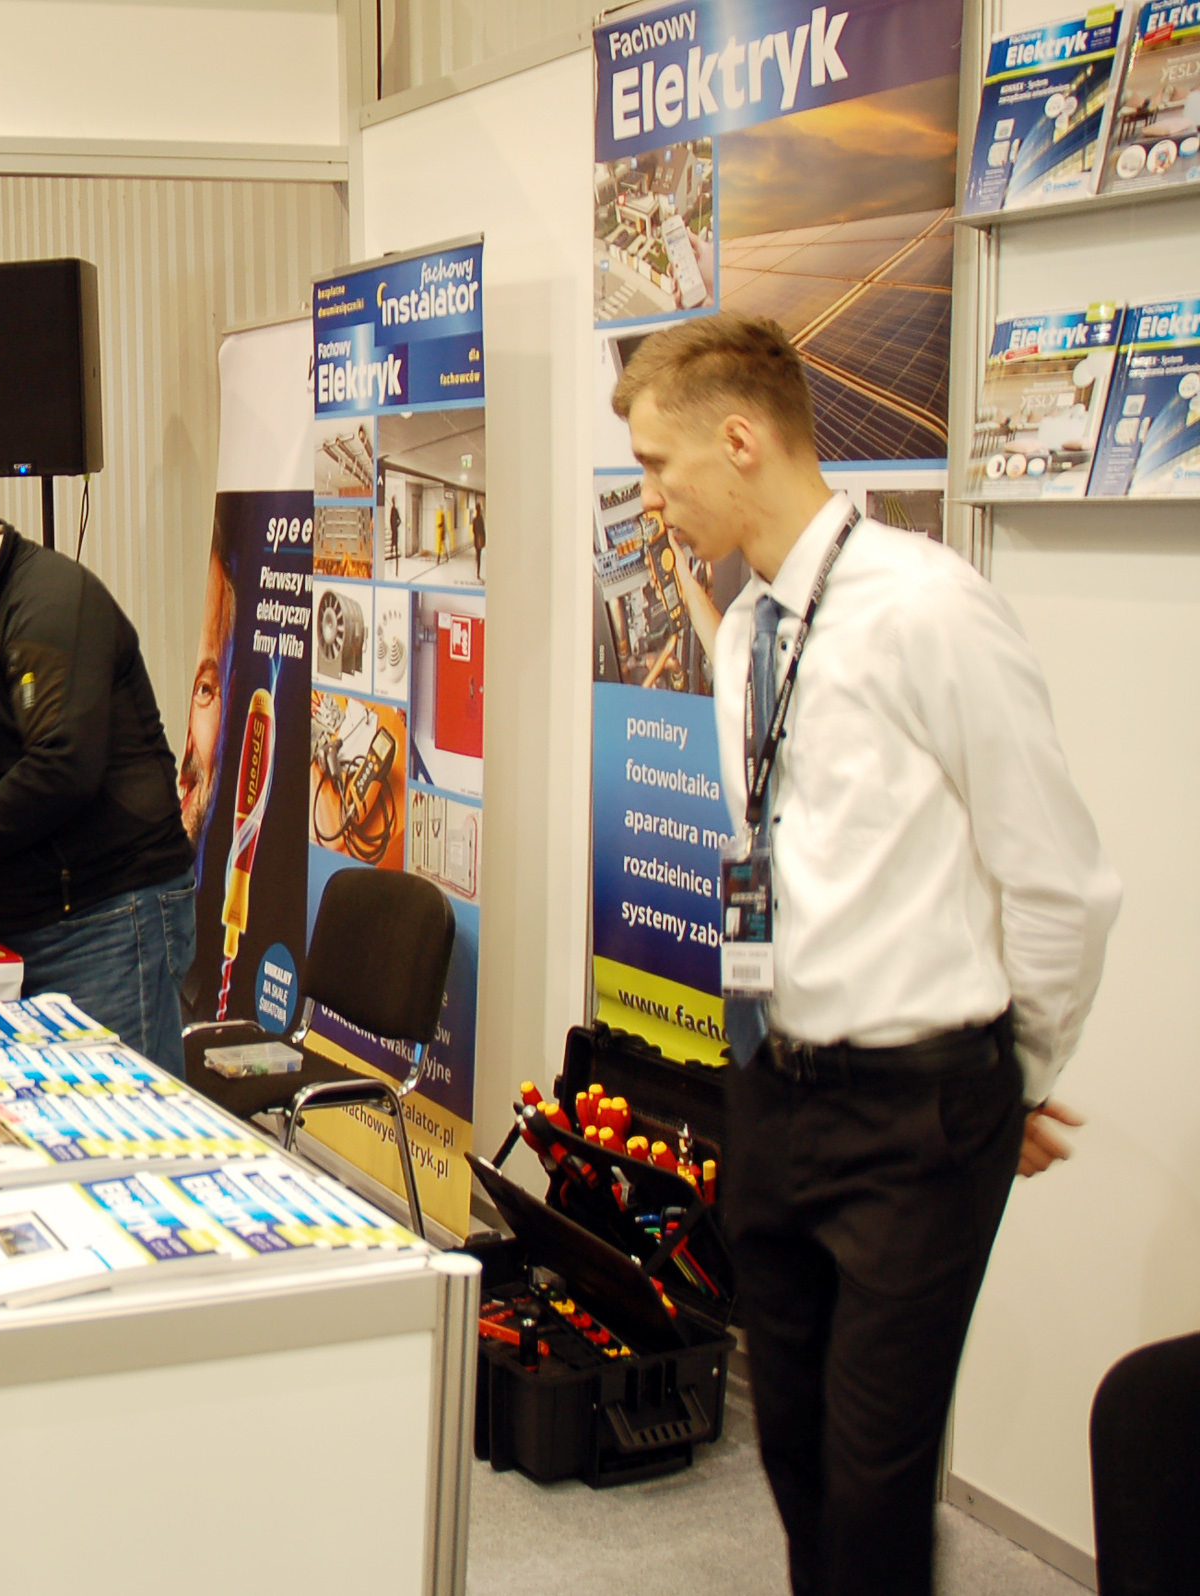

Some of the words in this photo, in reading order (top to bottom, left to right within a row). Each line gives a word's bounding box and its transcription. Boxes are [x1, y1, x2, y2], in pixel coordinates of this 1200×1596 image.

[608, 10, 697, 60] Fachowy
[1005, 30, 1089, 68] Elektryk
[611, 5, 849, 141] Elektryk
[419, 257, 474, 290] fachowy
[377, 280, 479, 327] instalator
[317, 339, 352, 360] Fachowy
[1009, 322, 1089, 349] Elektryk
[318, 353, 402, 405] Elektryk
[260, 565, 304, 597] Pierwszy
[256, 598, 311, 631] elektryczny
[252, 629, 277, 659] firmy
[278, 632, 304, 659] Wiha
[626, 715, 688, 750] pomiary
[625, 758, 720, 801] fotowoltaika
[624, 809, 698, 846] aparatura
[623, 853, 712, 898] rozdzielnice
[621, 900, 687, 943] systemy
